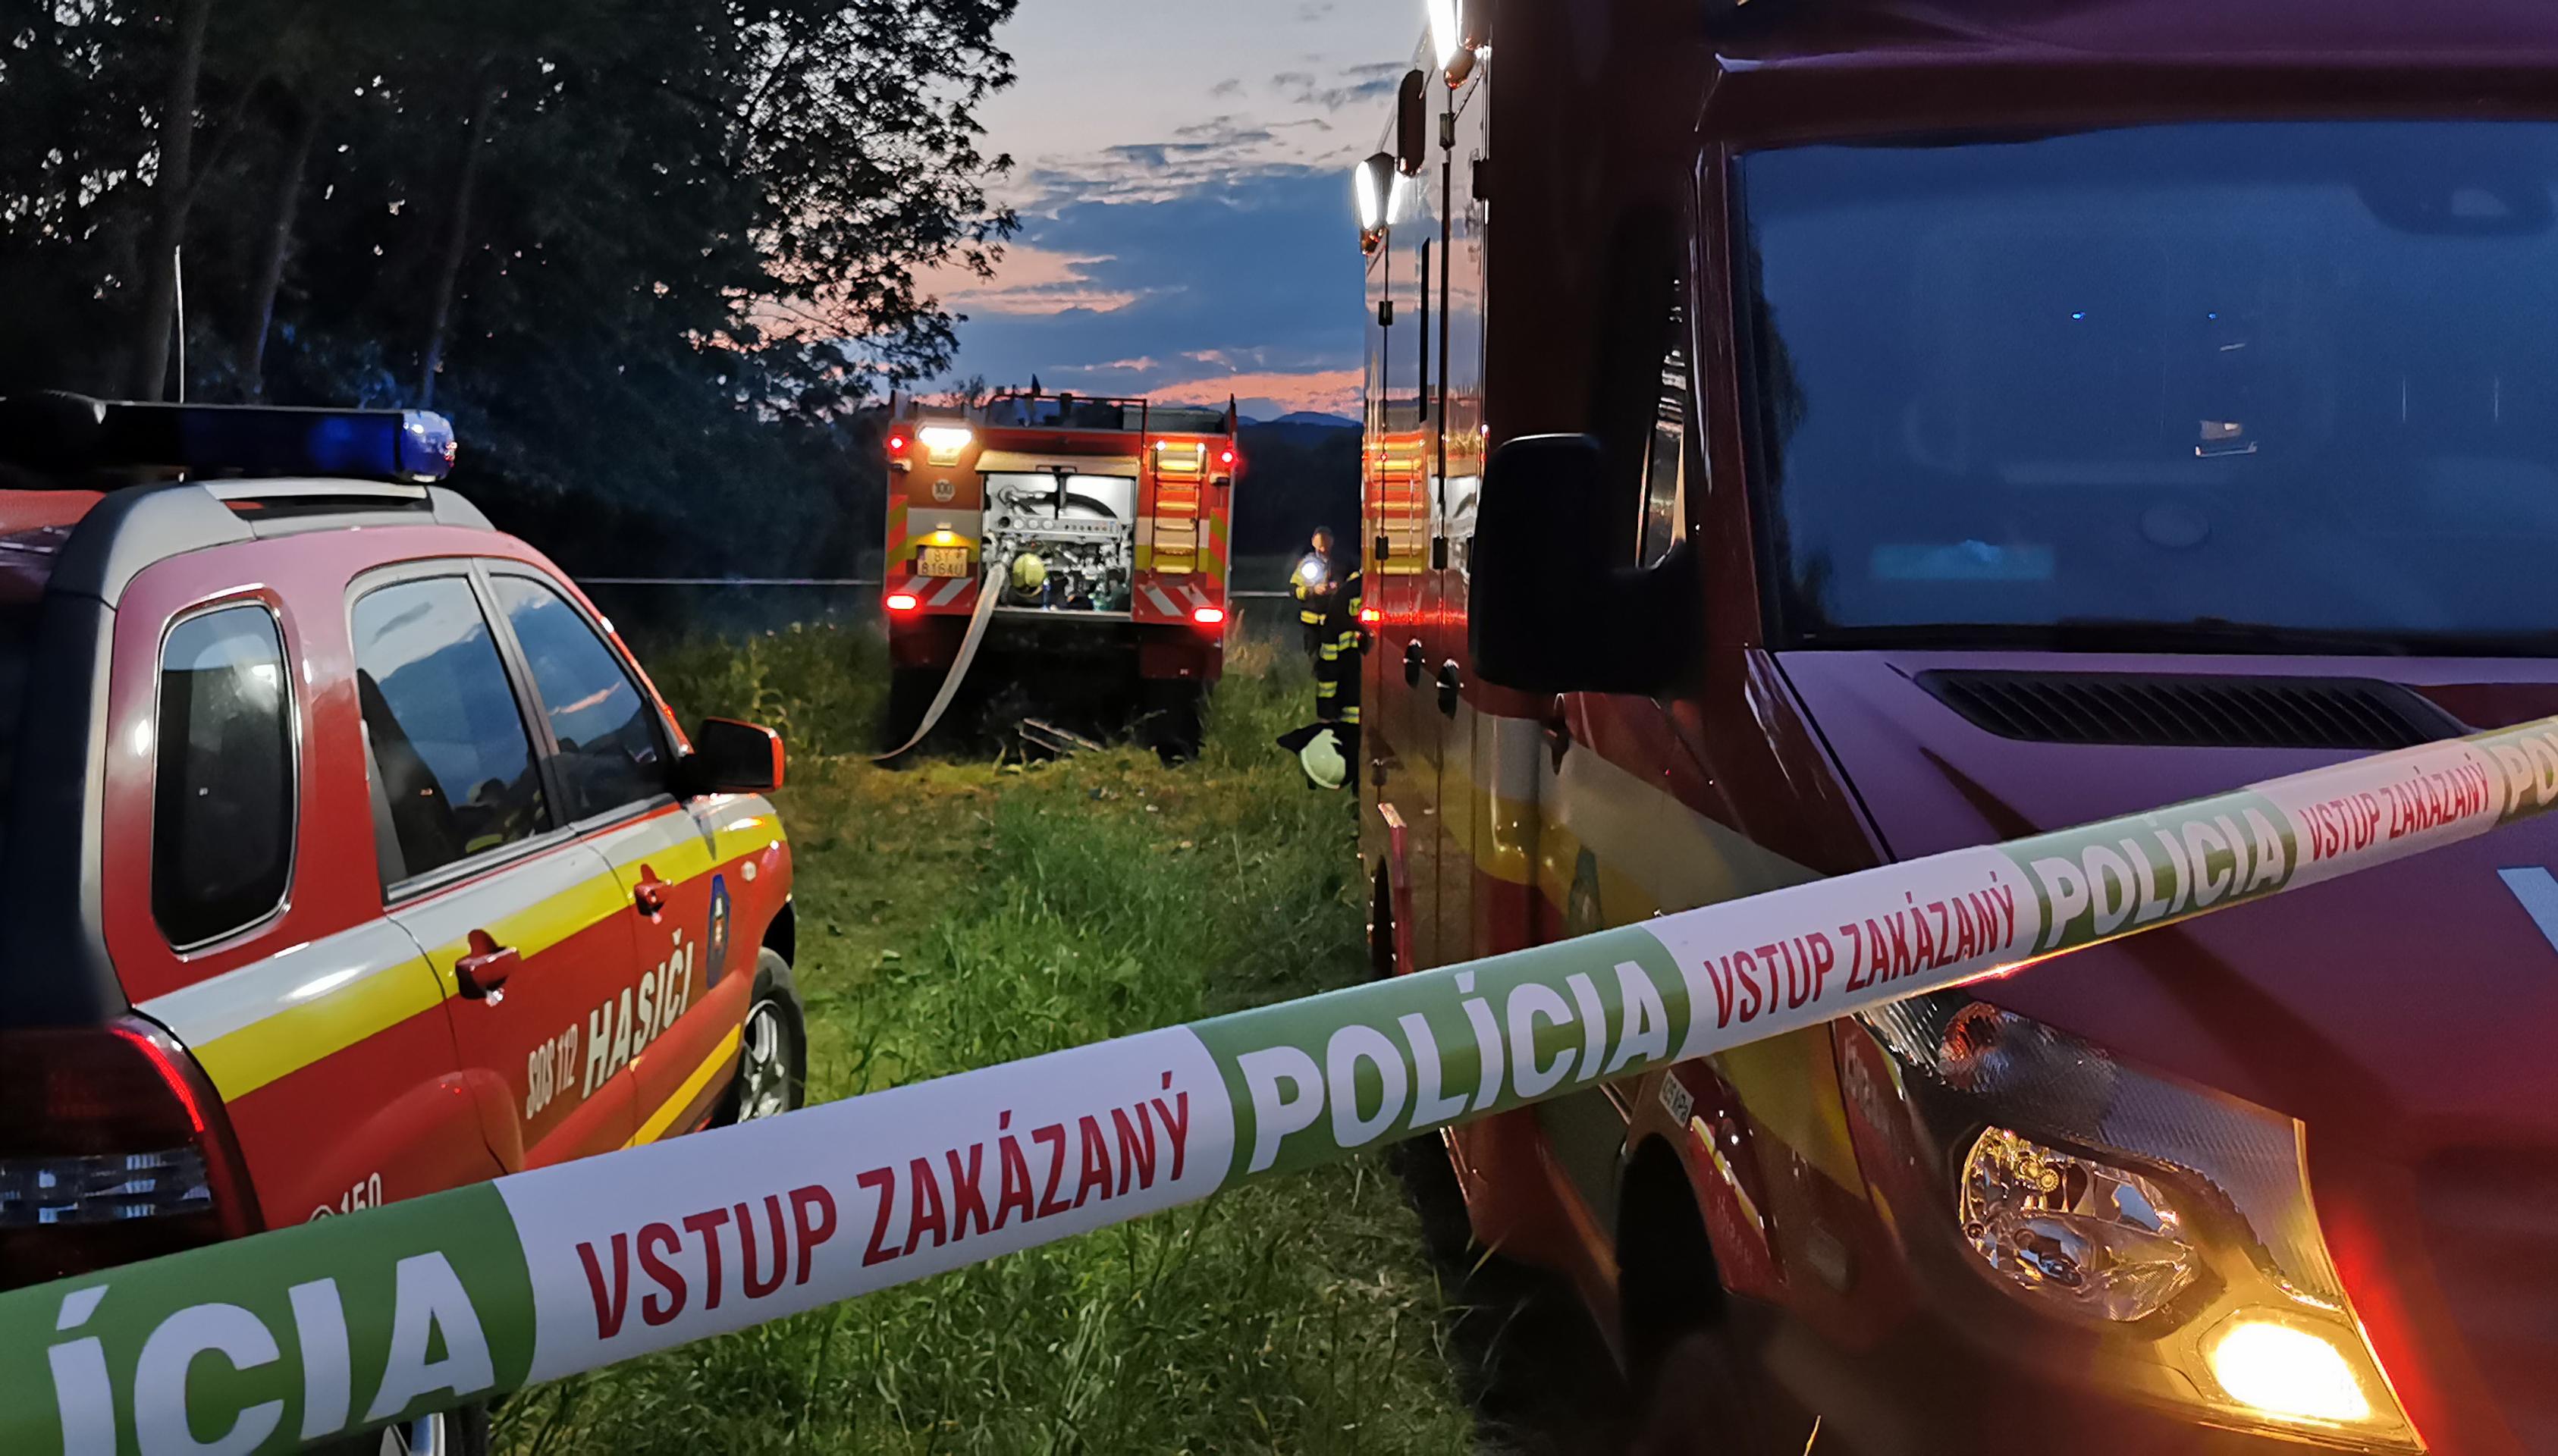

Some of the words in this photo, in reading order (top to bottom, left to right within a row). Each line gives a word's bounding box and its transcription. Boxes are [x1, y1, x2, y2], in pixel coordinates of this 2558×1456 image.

[48, 1250, 495, 1456] ÍCIA
[576, 1184, 837, 1340] VSTUP
[857, 1070, 1188, 1268] ZAKÁZANÝ
[1236, 960, 1669, 1174] POLÍCIA
[1703, 932, 1835, 1029] VSTUP
[1839, 871, 2014, 993] ZAKÁZANÝ
[2029, 807, 2286, 949] POLÍCIA
[2299, 792, 2381, 861] VSTUP
[2379, 752, 2489, 839] ZAKÁZANÝ
[2488, 733, 2558, 814] PO
[526, 1050, 555, 1120] SOS
[556, 1023, 578, 1096] 112
[582, 927, 694, 1100] HASIČI
